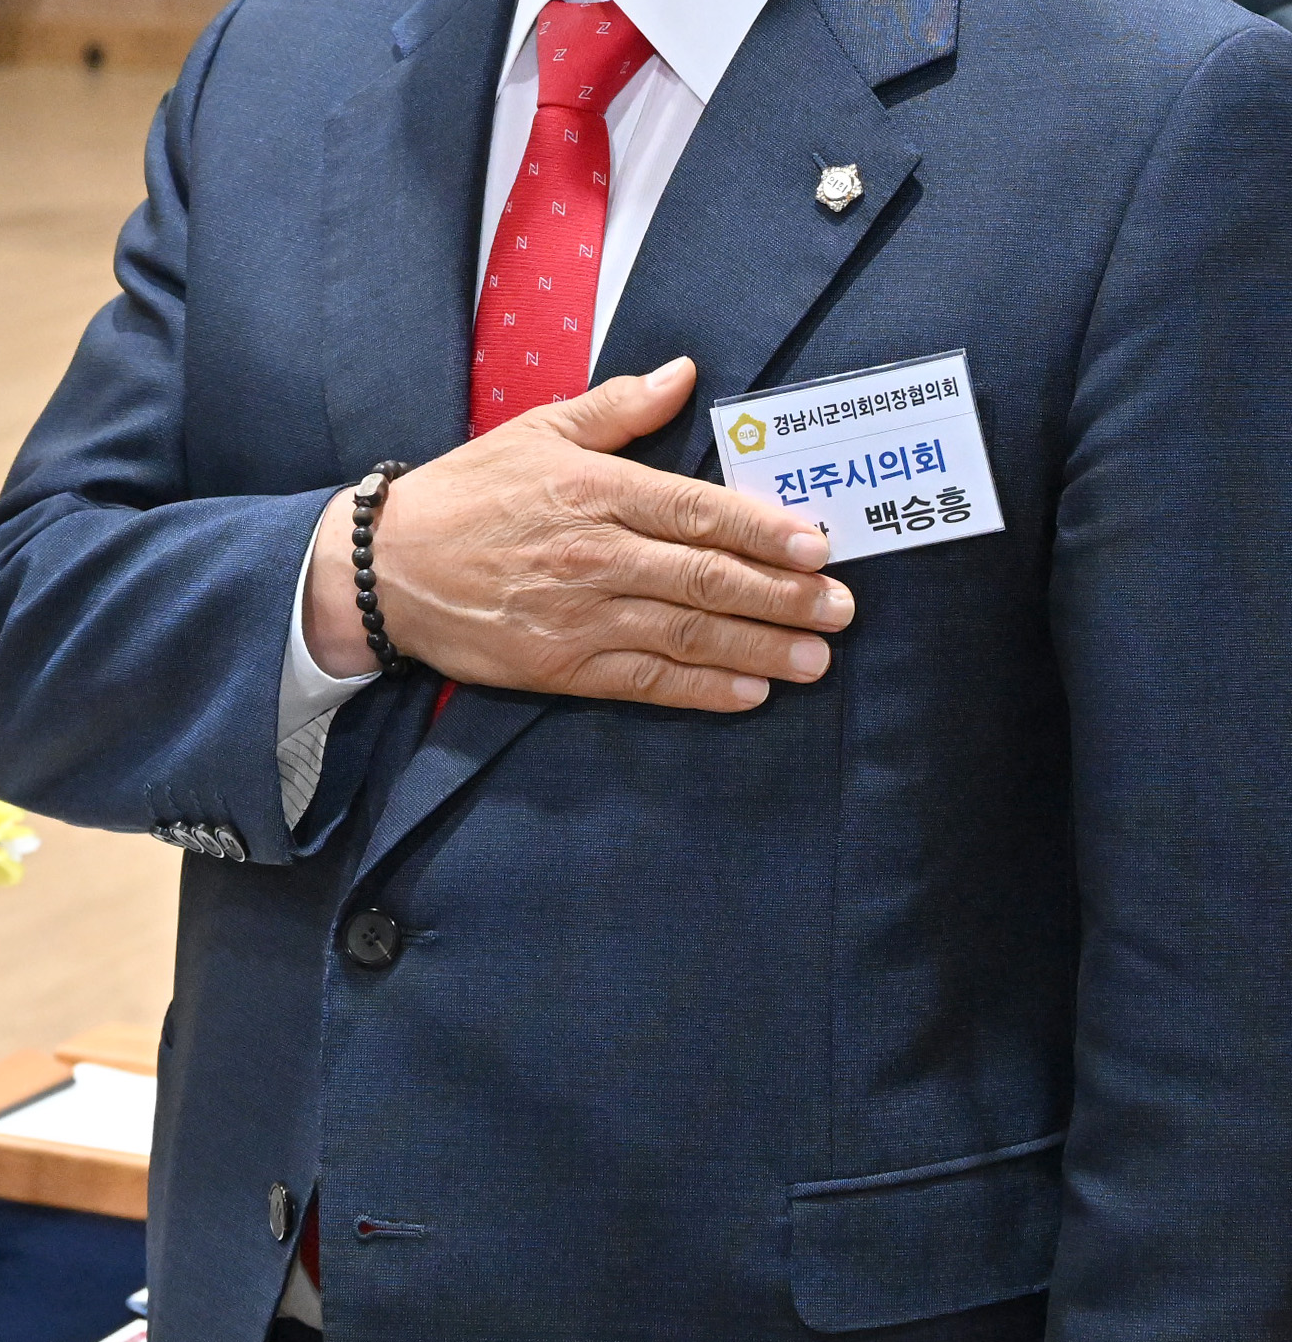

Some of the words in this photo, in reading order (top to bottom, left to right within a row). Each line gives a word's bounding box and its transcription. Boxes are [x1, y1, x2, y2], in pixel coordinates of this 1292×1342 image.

[773, 376, 959, 436] 경남시군의회의장협의회
[739, 428, 758, 440] 의회
[774, 439, 947, 507] 진주시의회
[864, 486, 972, 535] 백승흥
